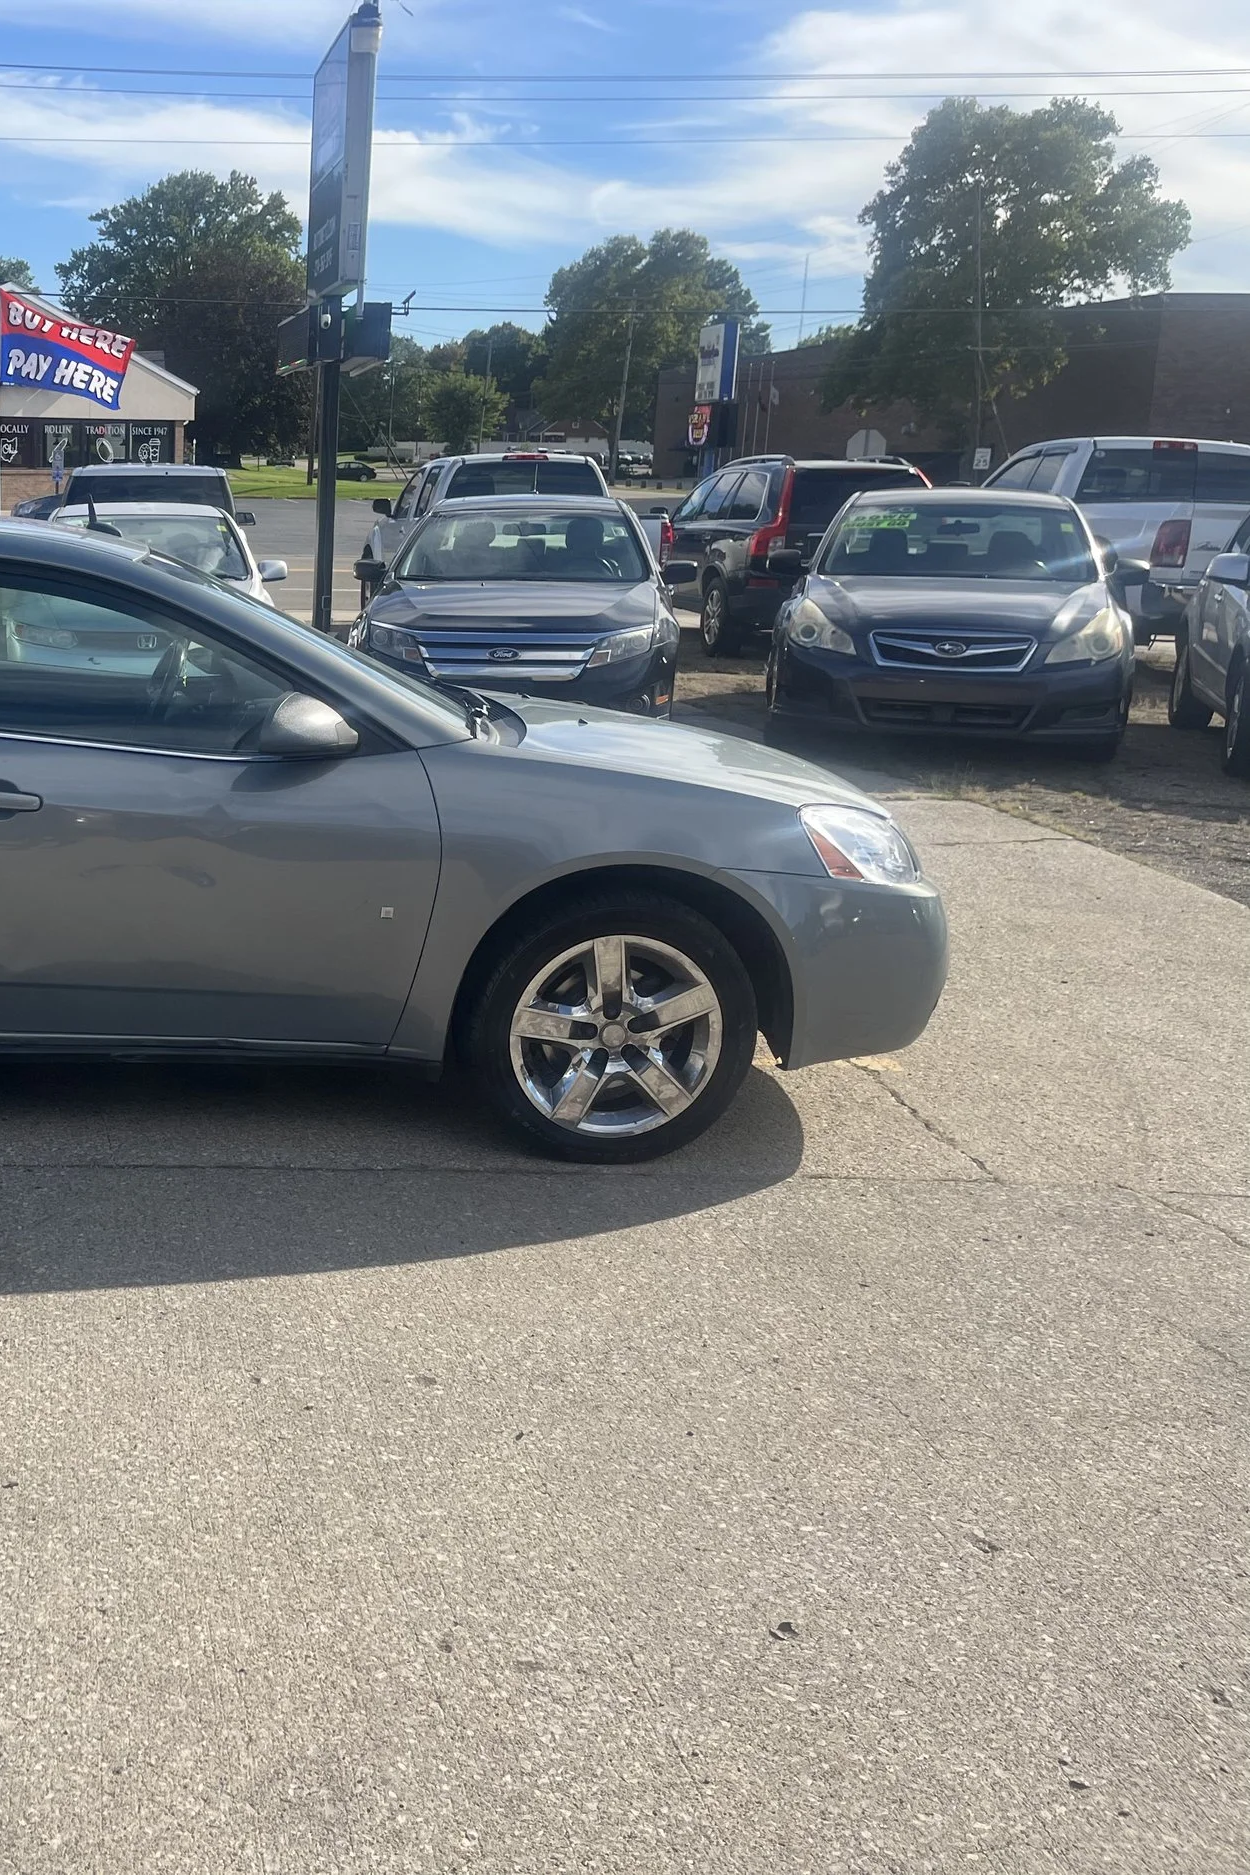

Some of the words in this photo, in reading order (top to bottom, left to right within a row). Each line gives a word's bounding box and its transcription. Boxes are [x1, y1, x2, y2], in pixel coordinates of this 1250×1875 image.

[8, 301, 54, 333] BUY
[61, 325, 131, 359] HERE
[7, 348, 53, 381] PAY
[53, 359, 119, 404] HERE
[0, 424, 29, 433] OCALLY
[85, 425, 126, 435] TRADITION
[132, 426, 152, 436] SINCE
[153, 427, 168, 436] 1947
[854, 513, 911, 521] DOWN
[844, 520, 881, 528] MUST
